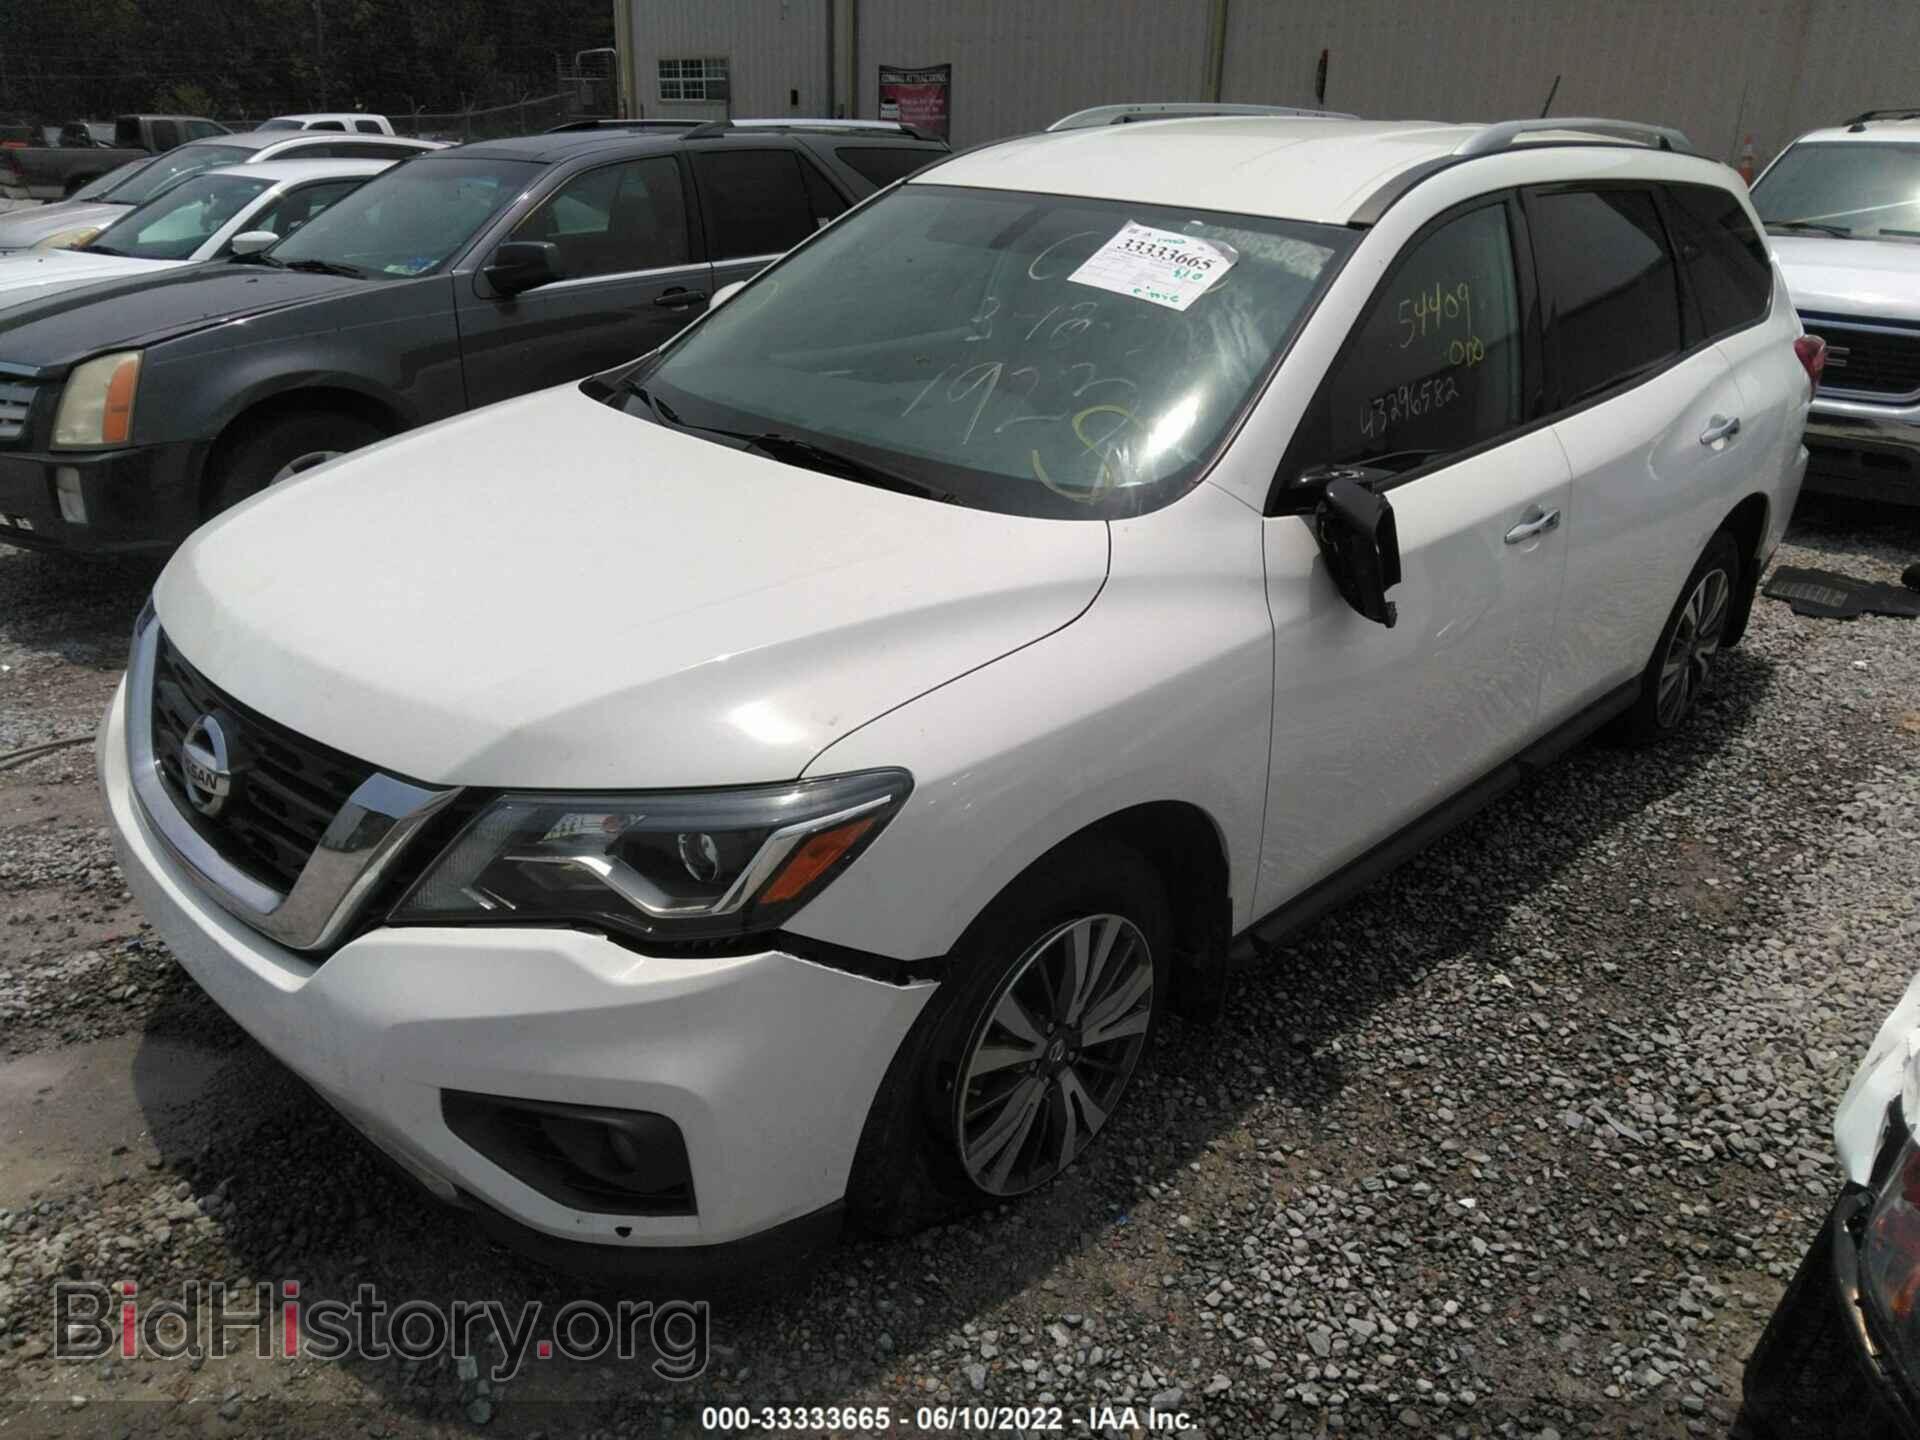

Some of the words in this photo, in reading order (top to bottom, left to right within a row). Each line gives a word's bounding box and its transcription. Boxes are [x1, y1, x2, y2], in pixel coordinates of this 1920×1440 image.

[1116, 239, 1216, 270] 33333665
[1398, 281, 1472, 348] 54409
[1359, 376, 1461, 439] 43296582
